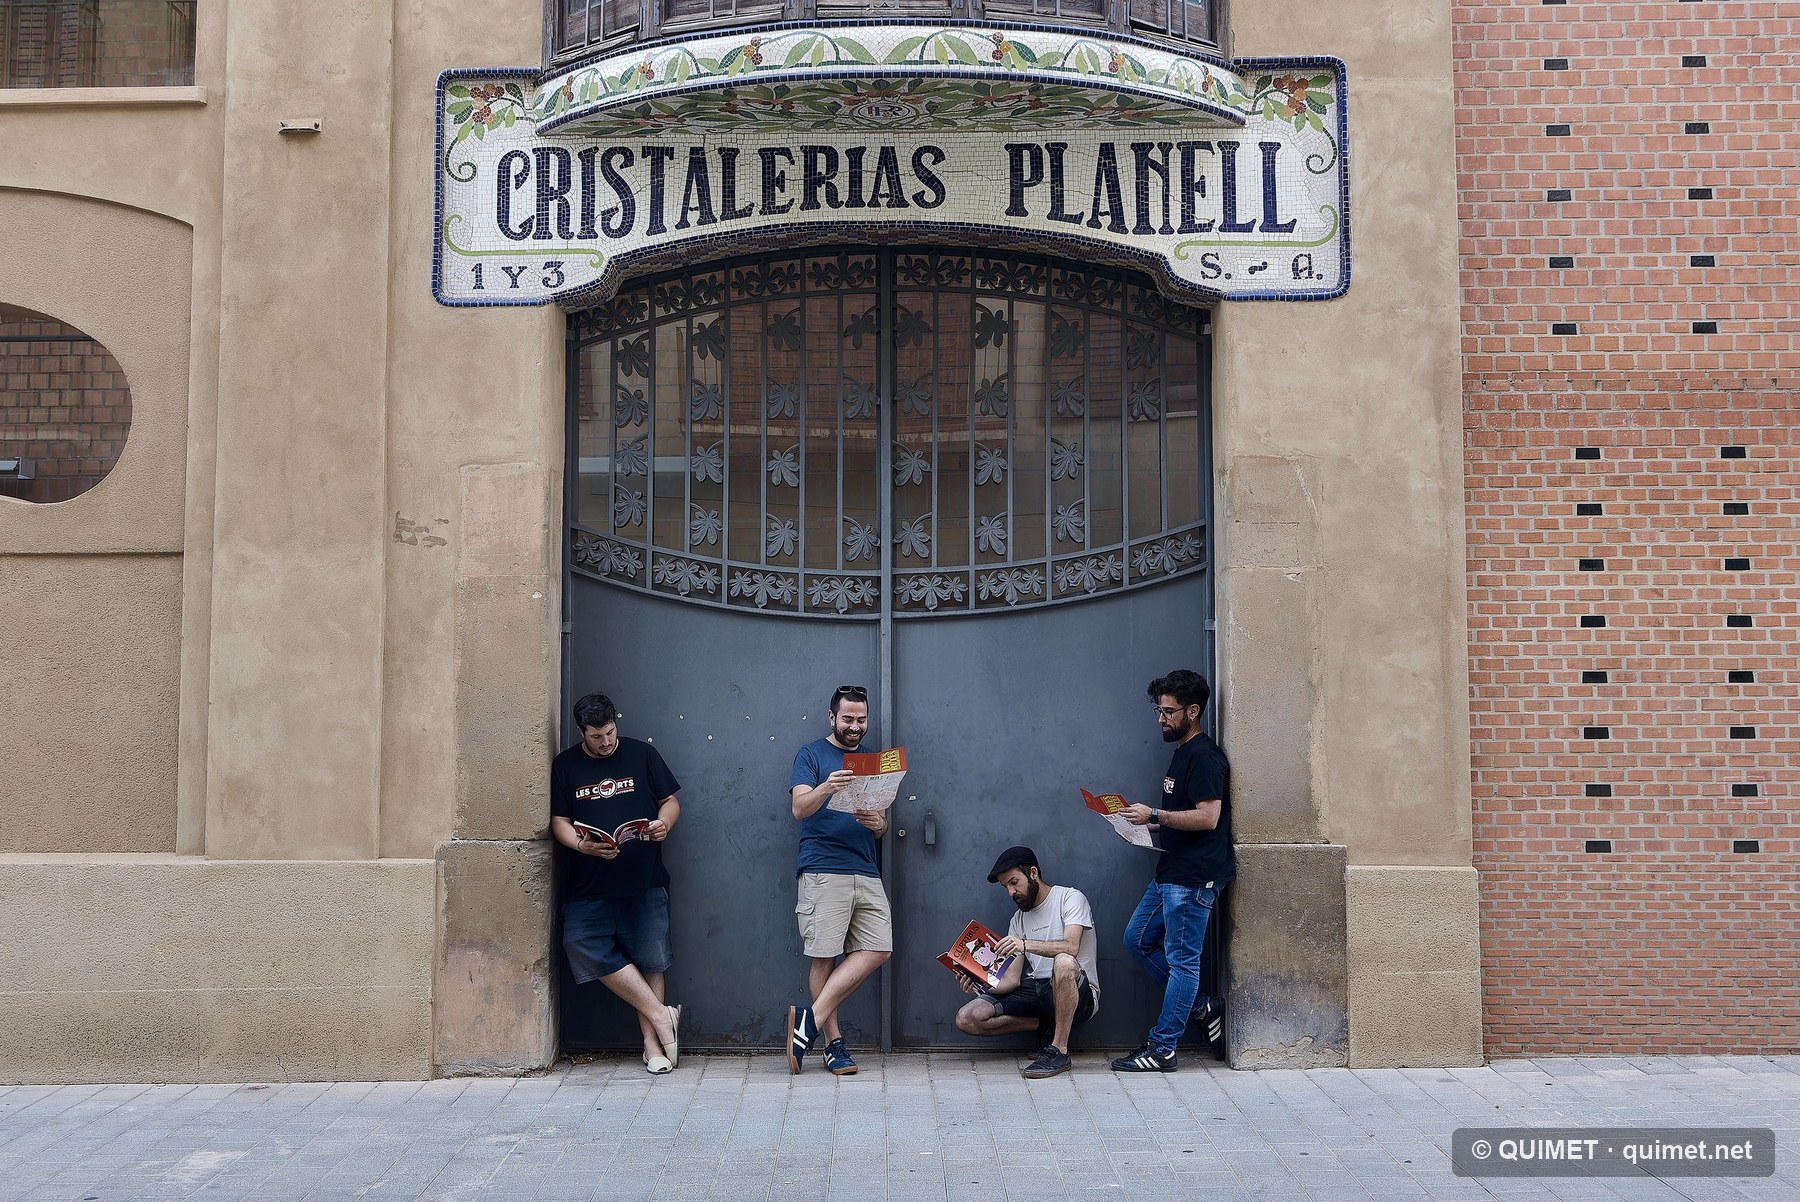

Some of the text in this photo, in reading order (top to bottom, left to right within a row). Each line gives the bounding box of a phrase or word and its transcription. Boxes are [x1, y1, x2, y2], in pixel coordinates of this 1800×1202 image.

[496, 141, 1297, 241] CRISTALERIAS PLANELL
[472, 261, 565, 290] 1 Y 3
[1200, 252, 1232, 280] S.
[575, 788, 591, 799] LES
